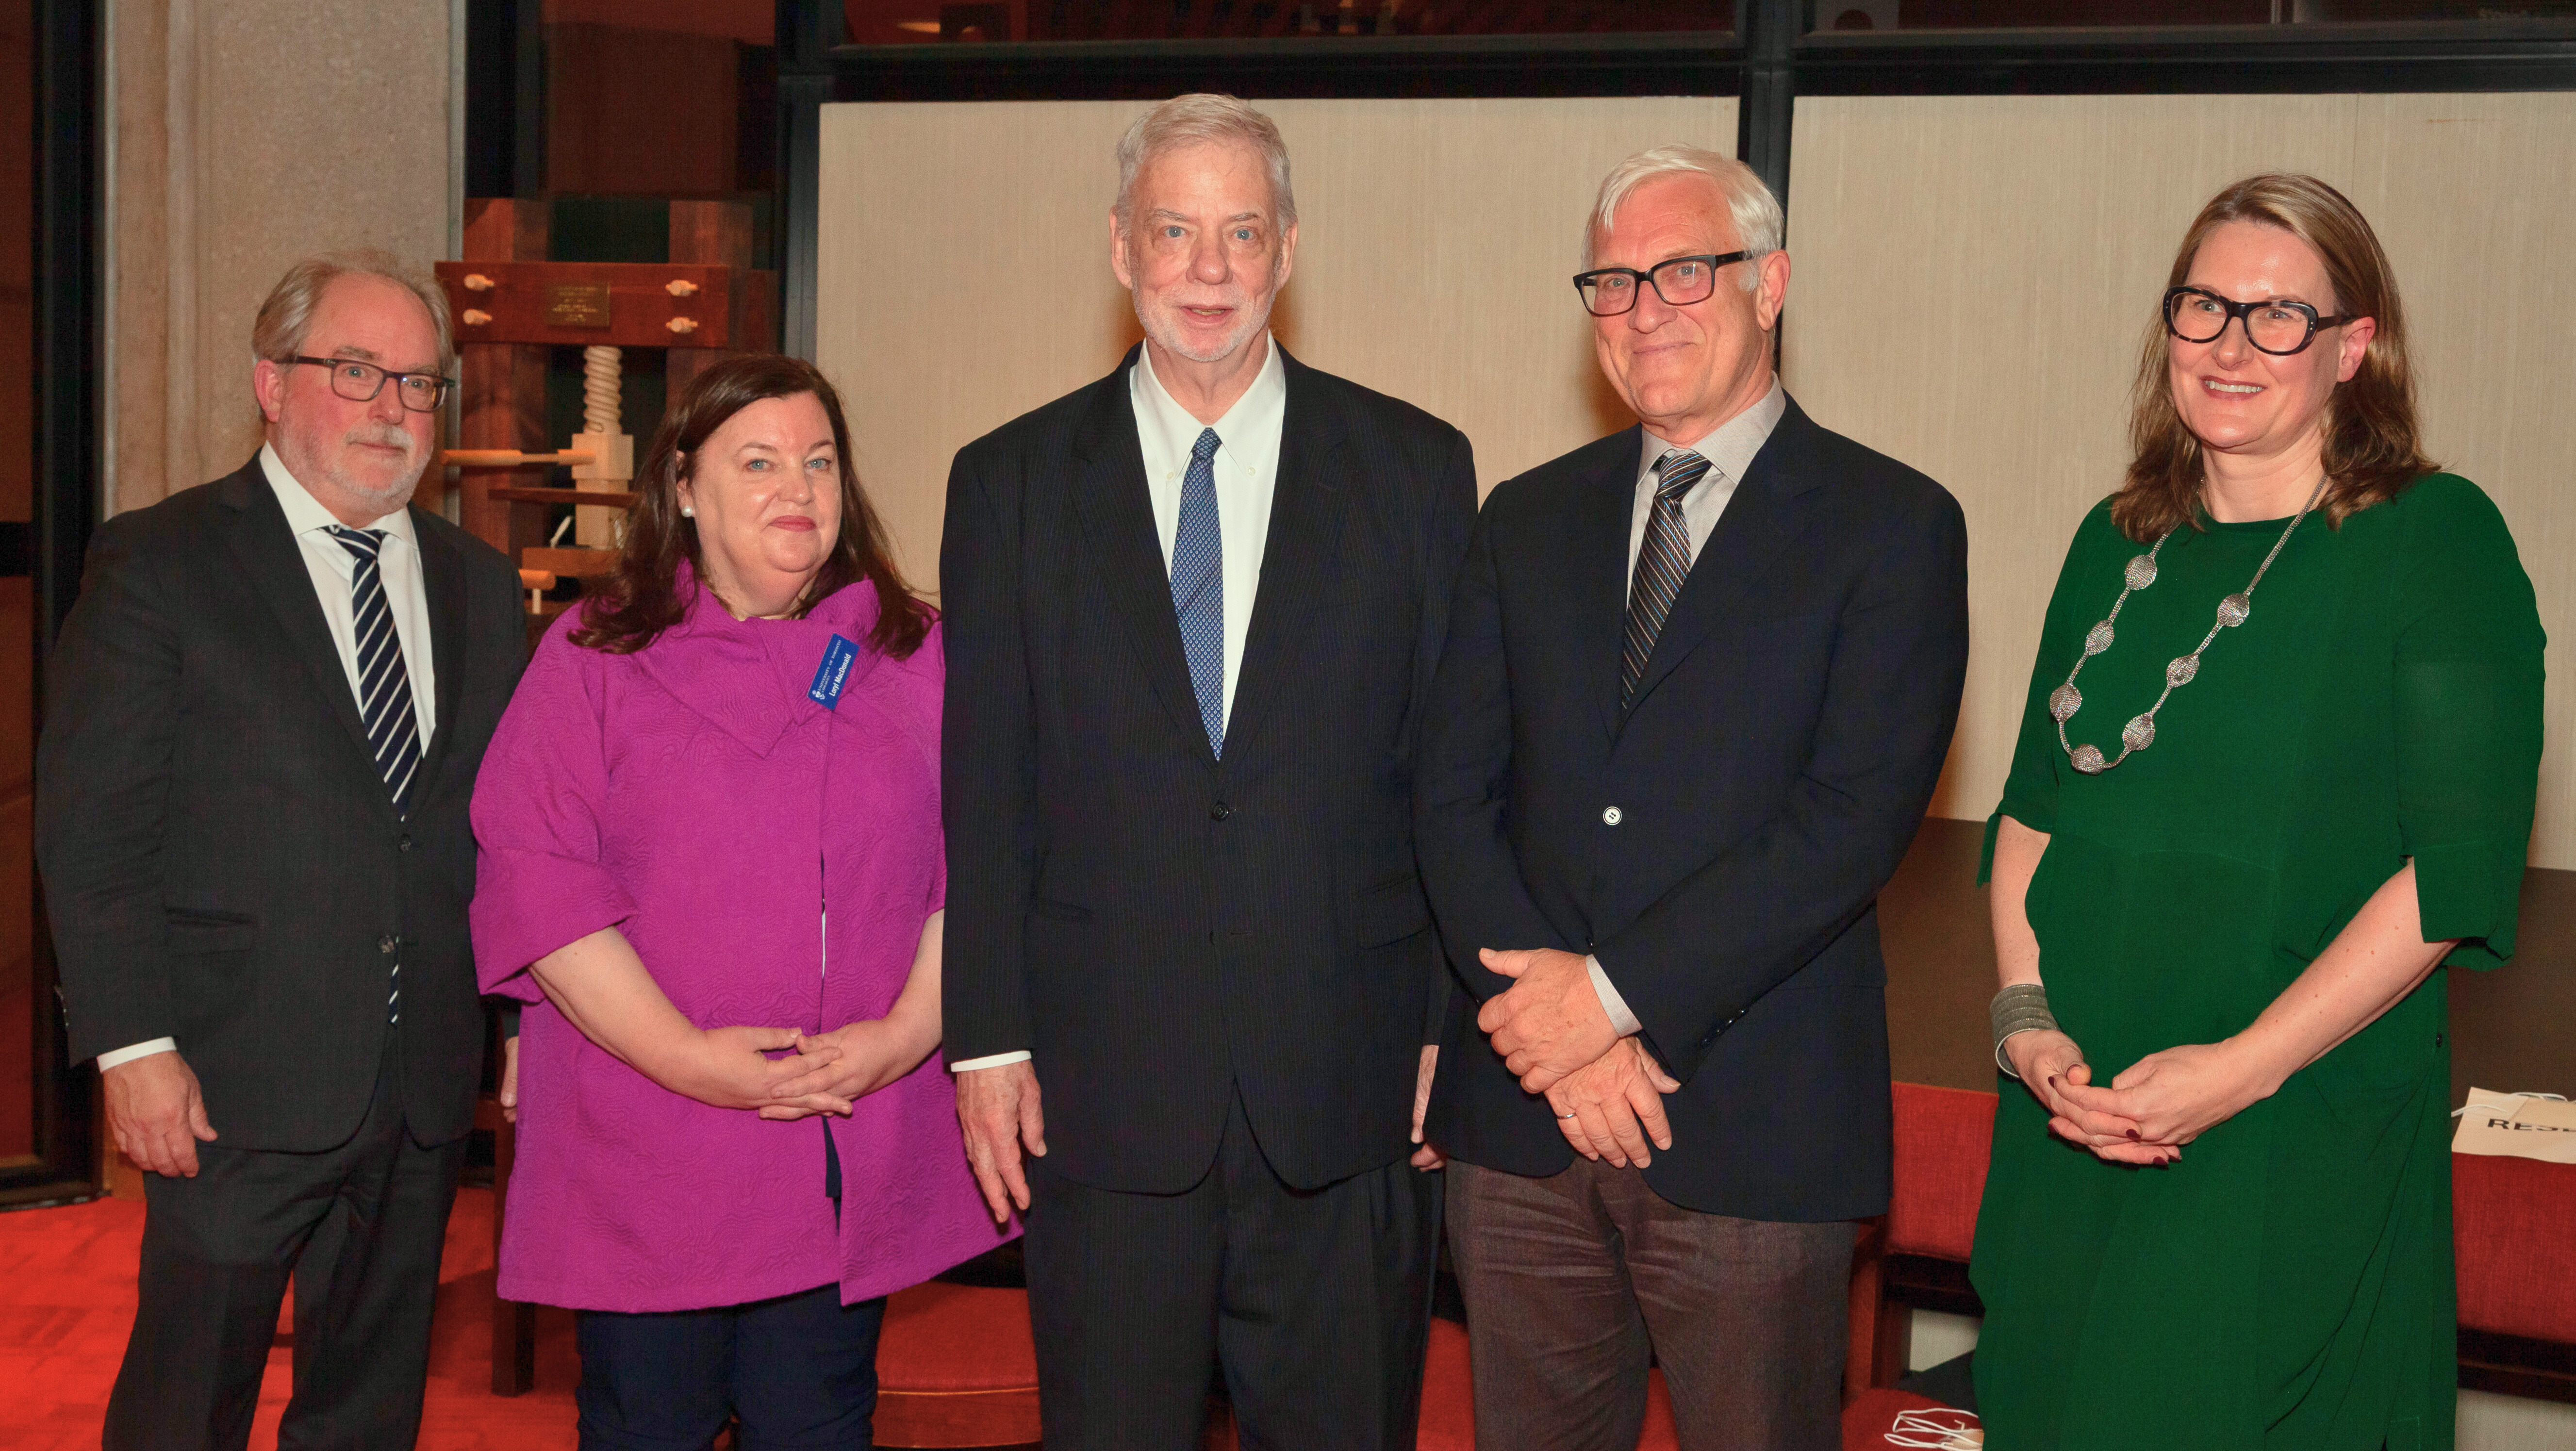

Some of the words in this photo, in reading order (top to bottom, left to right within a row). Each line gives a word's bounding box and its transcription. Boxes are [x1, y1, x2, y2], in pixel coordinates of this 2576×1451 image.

[818, 667, 830, 691] UNIVERSITY
[831, 640, 841, 659] TORONTO
[829, 682, 839, 696] Loryl
[834, 653, 851, 683] MacDonald
